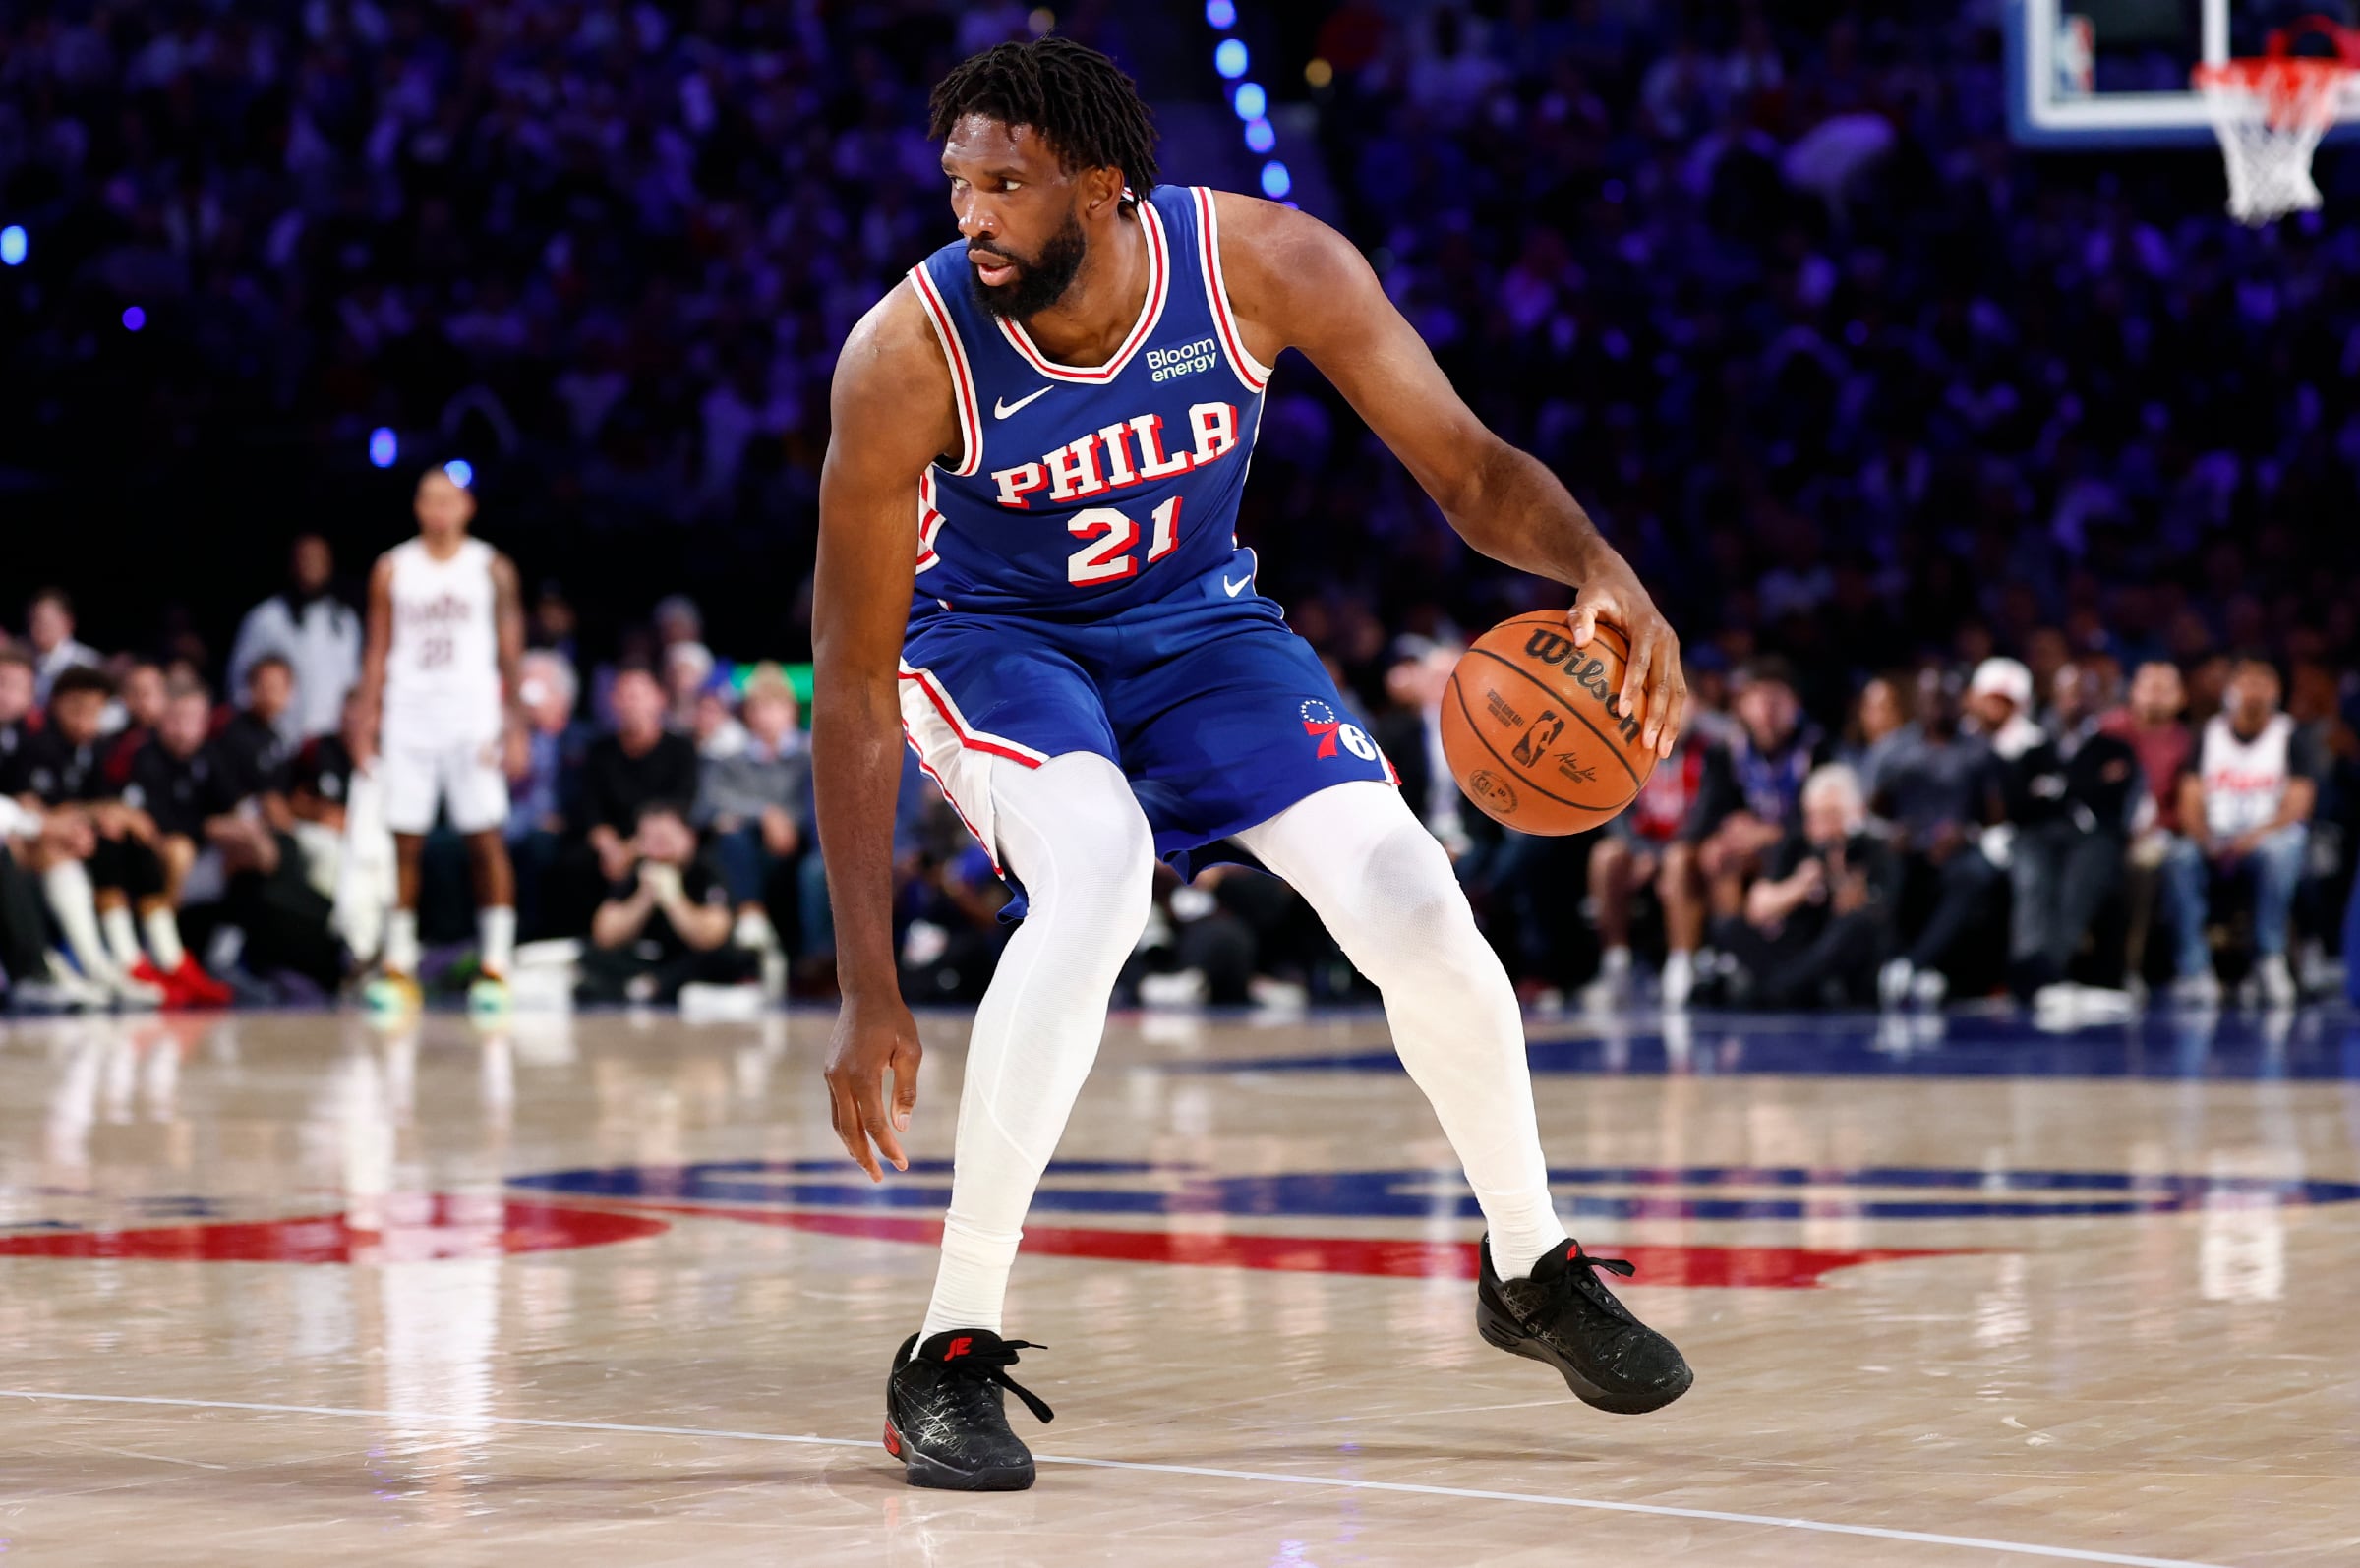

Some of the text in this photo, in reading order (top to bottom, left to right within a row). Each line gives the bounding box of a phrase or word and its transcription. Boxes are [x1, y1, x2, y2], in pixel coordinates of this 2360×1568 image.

[1146, 337, 1217, 370] Bloom
[1151, 350, 1218, 383] energy
[991, 401, 1240, 510] PHILA
[1067, 495, 1184, 588] 21
[1524, 627, 1642, 748] Wilson
[1302, 720, 1377, 761] 76
[943, 1337, 973, 1362] JE
